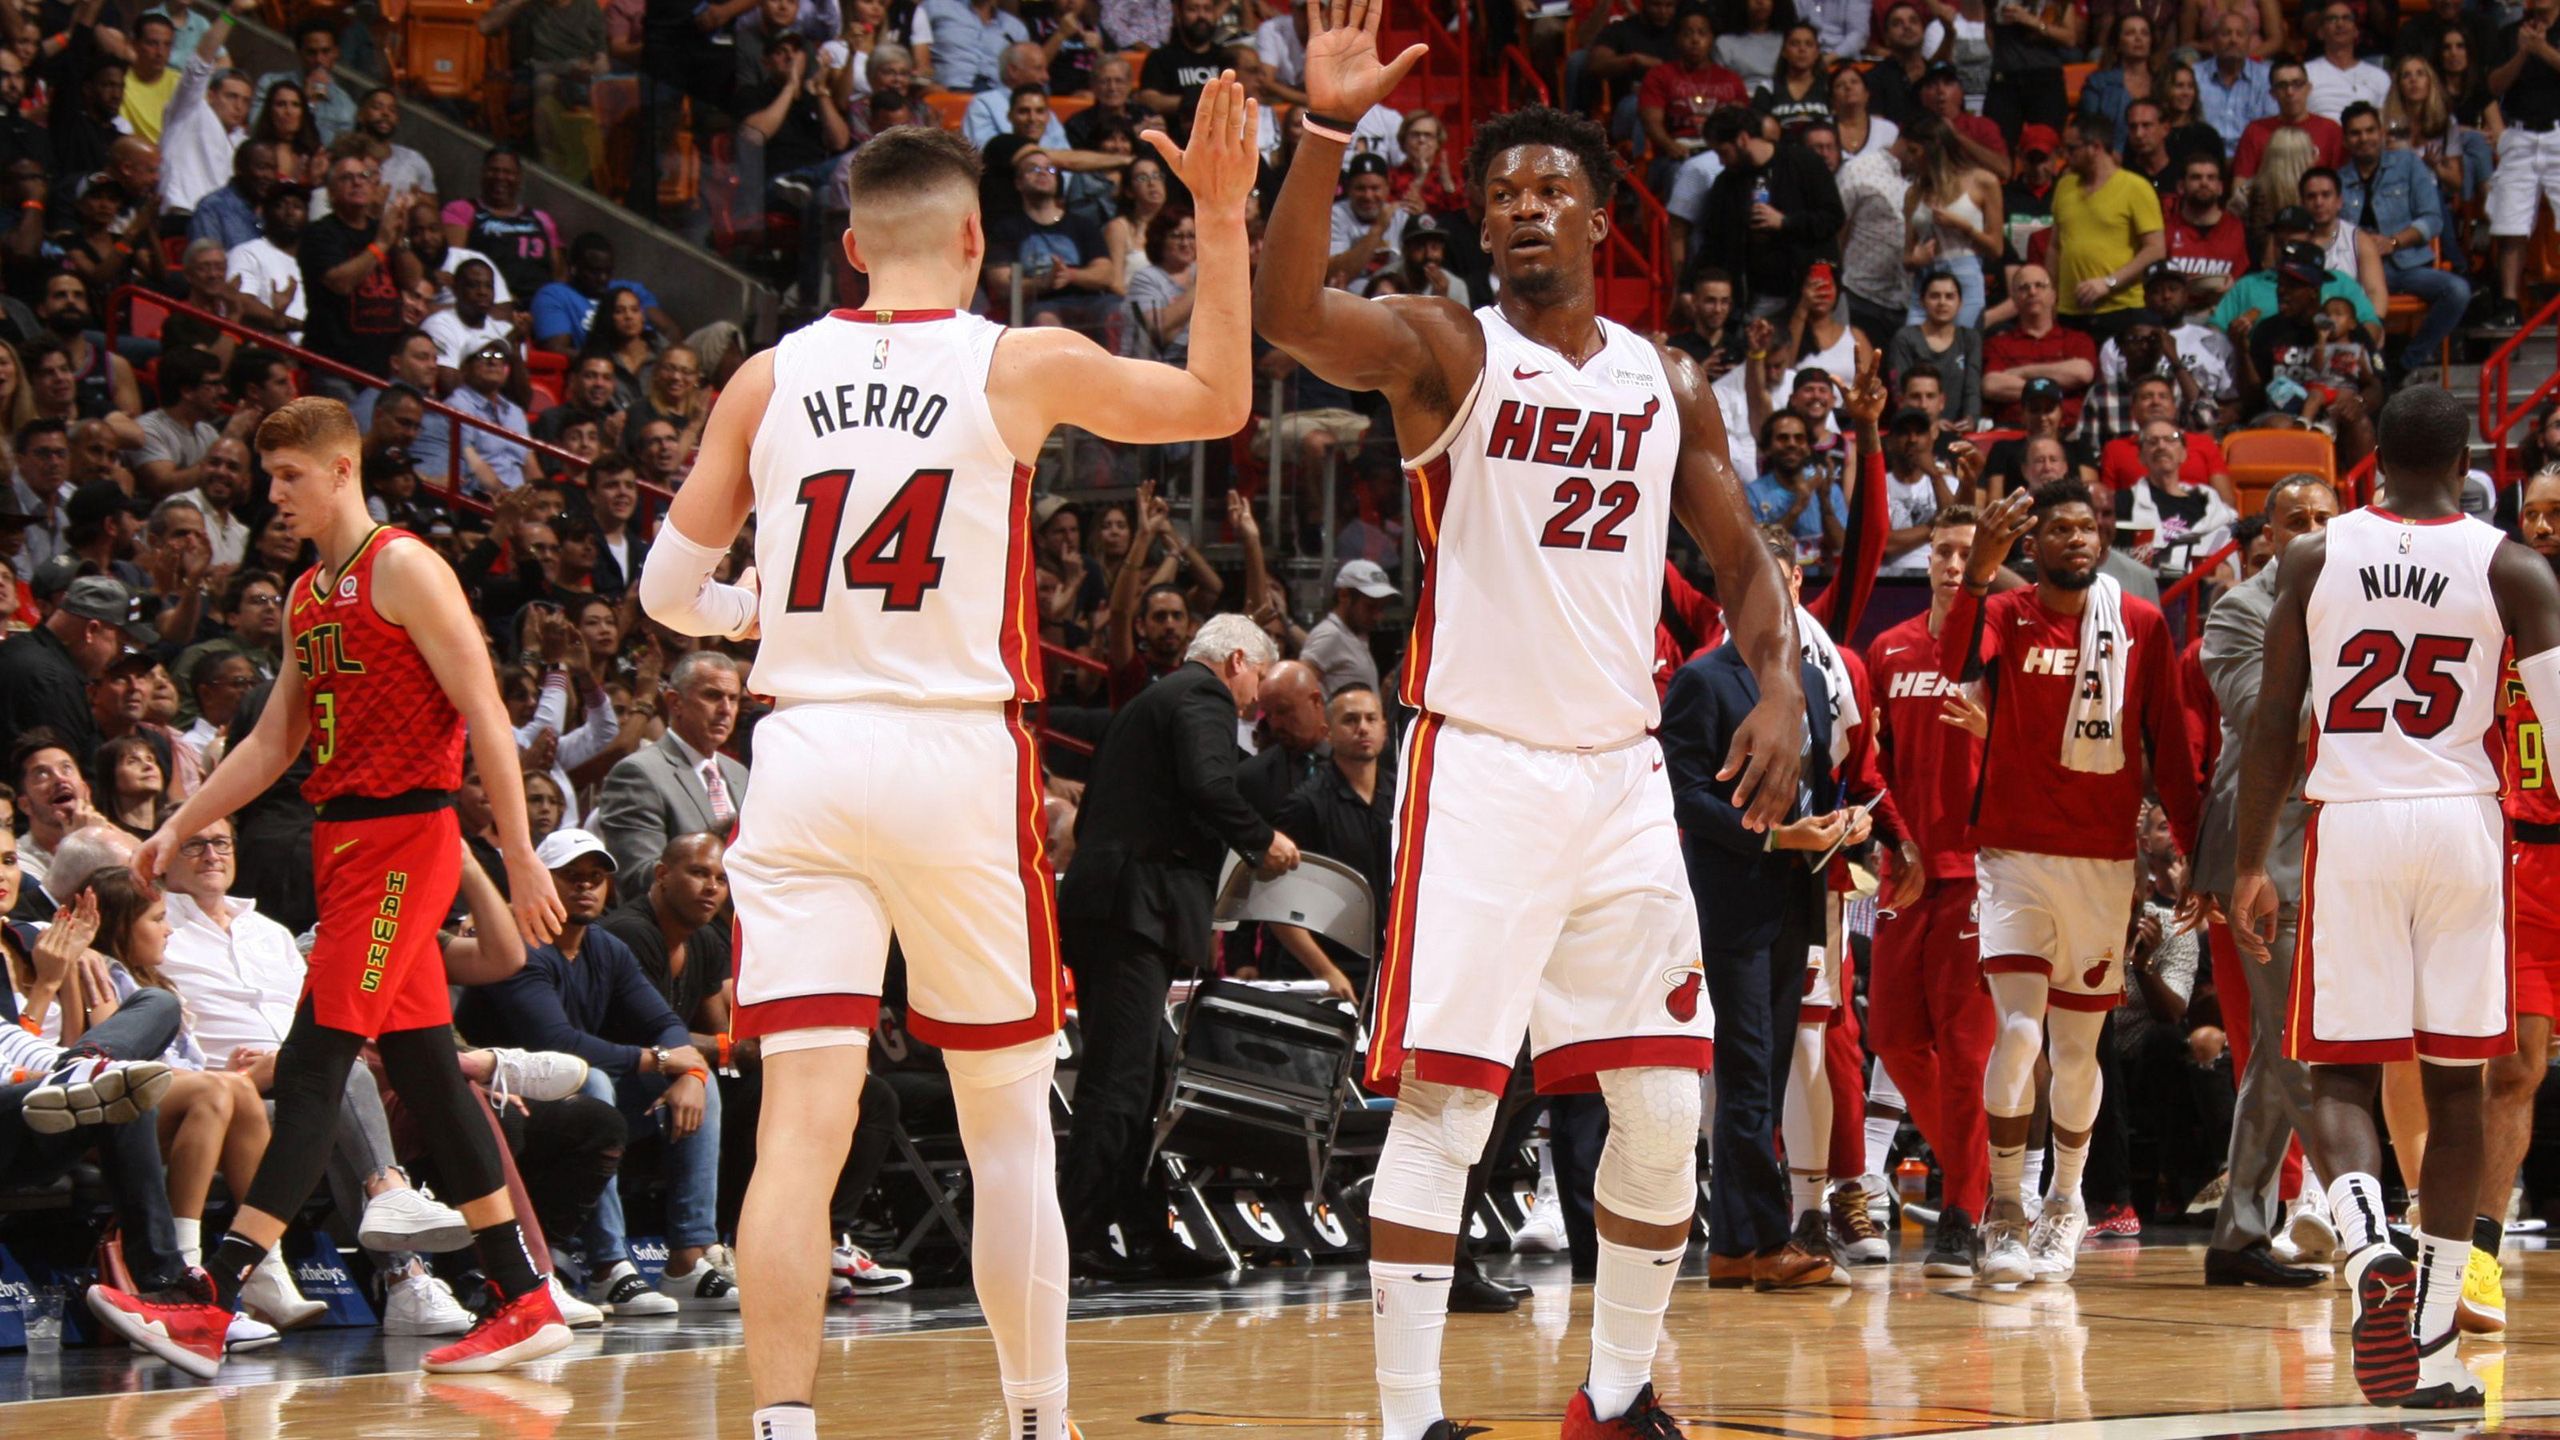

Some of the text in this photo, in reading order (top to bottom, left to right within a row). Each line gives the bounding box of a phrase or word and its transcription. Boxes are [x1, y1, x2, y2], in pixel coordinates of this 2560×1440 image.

[1771, 101, 1829, 116] MIAMI
[517, 235, 545, 258] 13
[2166, 256, 2234, 275] MIAMI
[802, 383, 949, 440] HERRO
[1485, 393, 1661, 472] HEAT
[785, 468, 954, 613] 14
[1539, 476, 1641, 553] 22
[2358, 563, 2450, 609] NUNN
[1888, 670, 1960, 698] HEA
[2022, 646, 2079, 676] HE
[2322, 628, 2475, 741] 25
[313, 691, 337, 767] 3
[2517, 721, 2544, 790] 9
[360, 870, 408, 993] HAWKS
